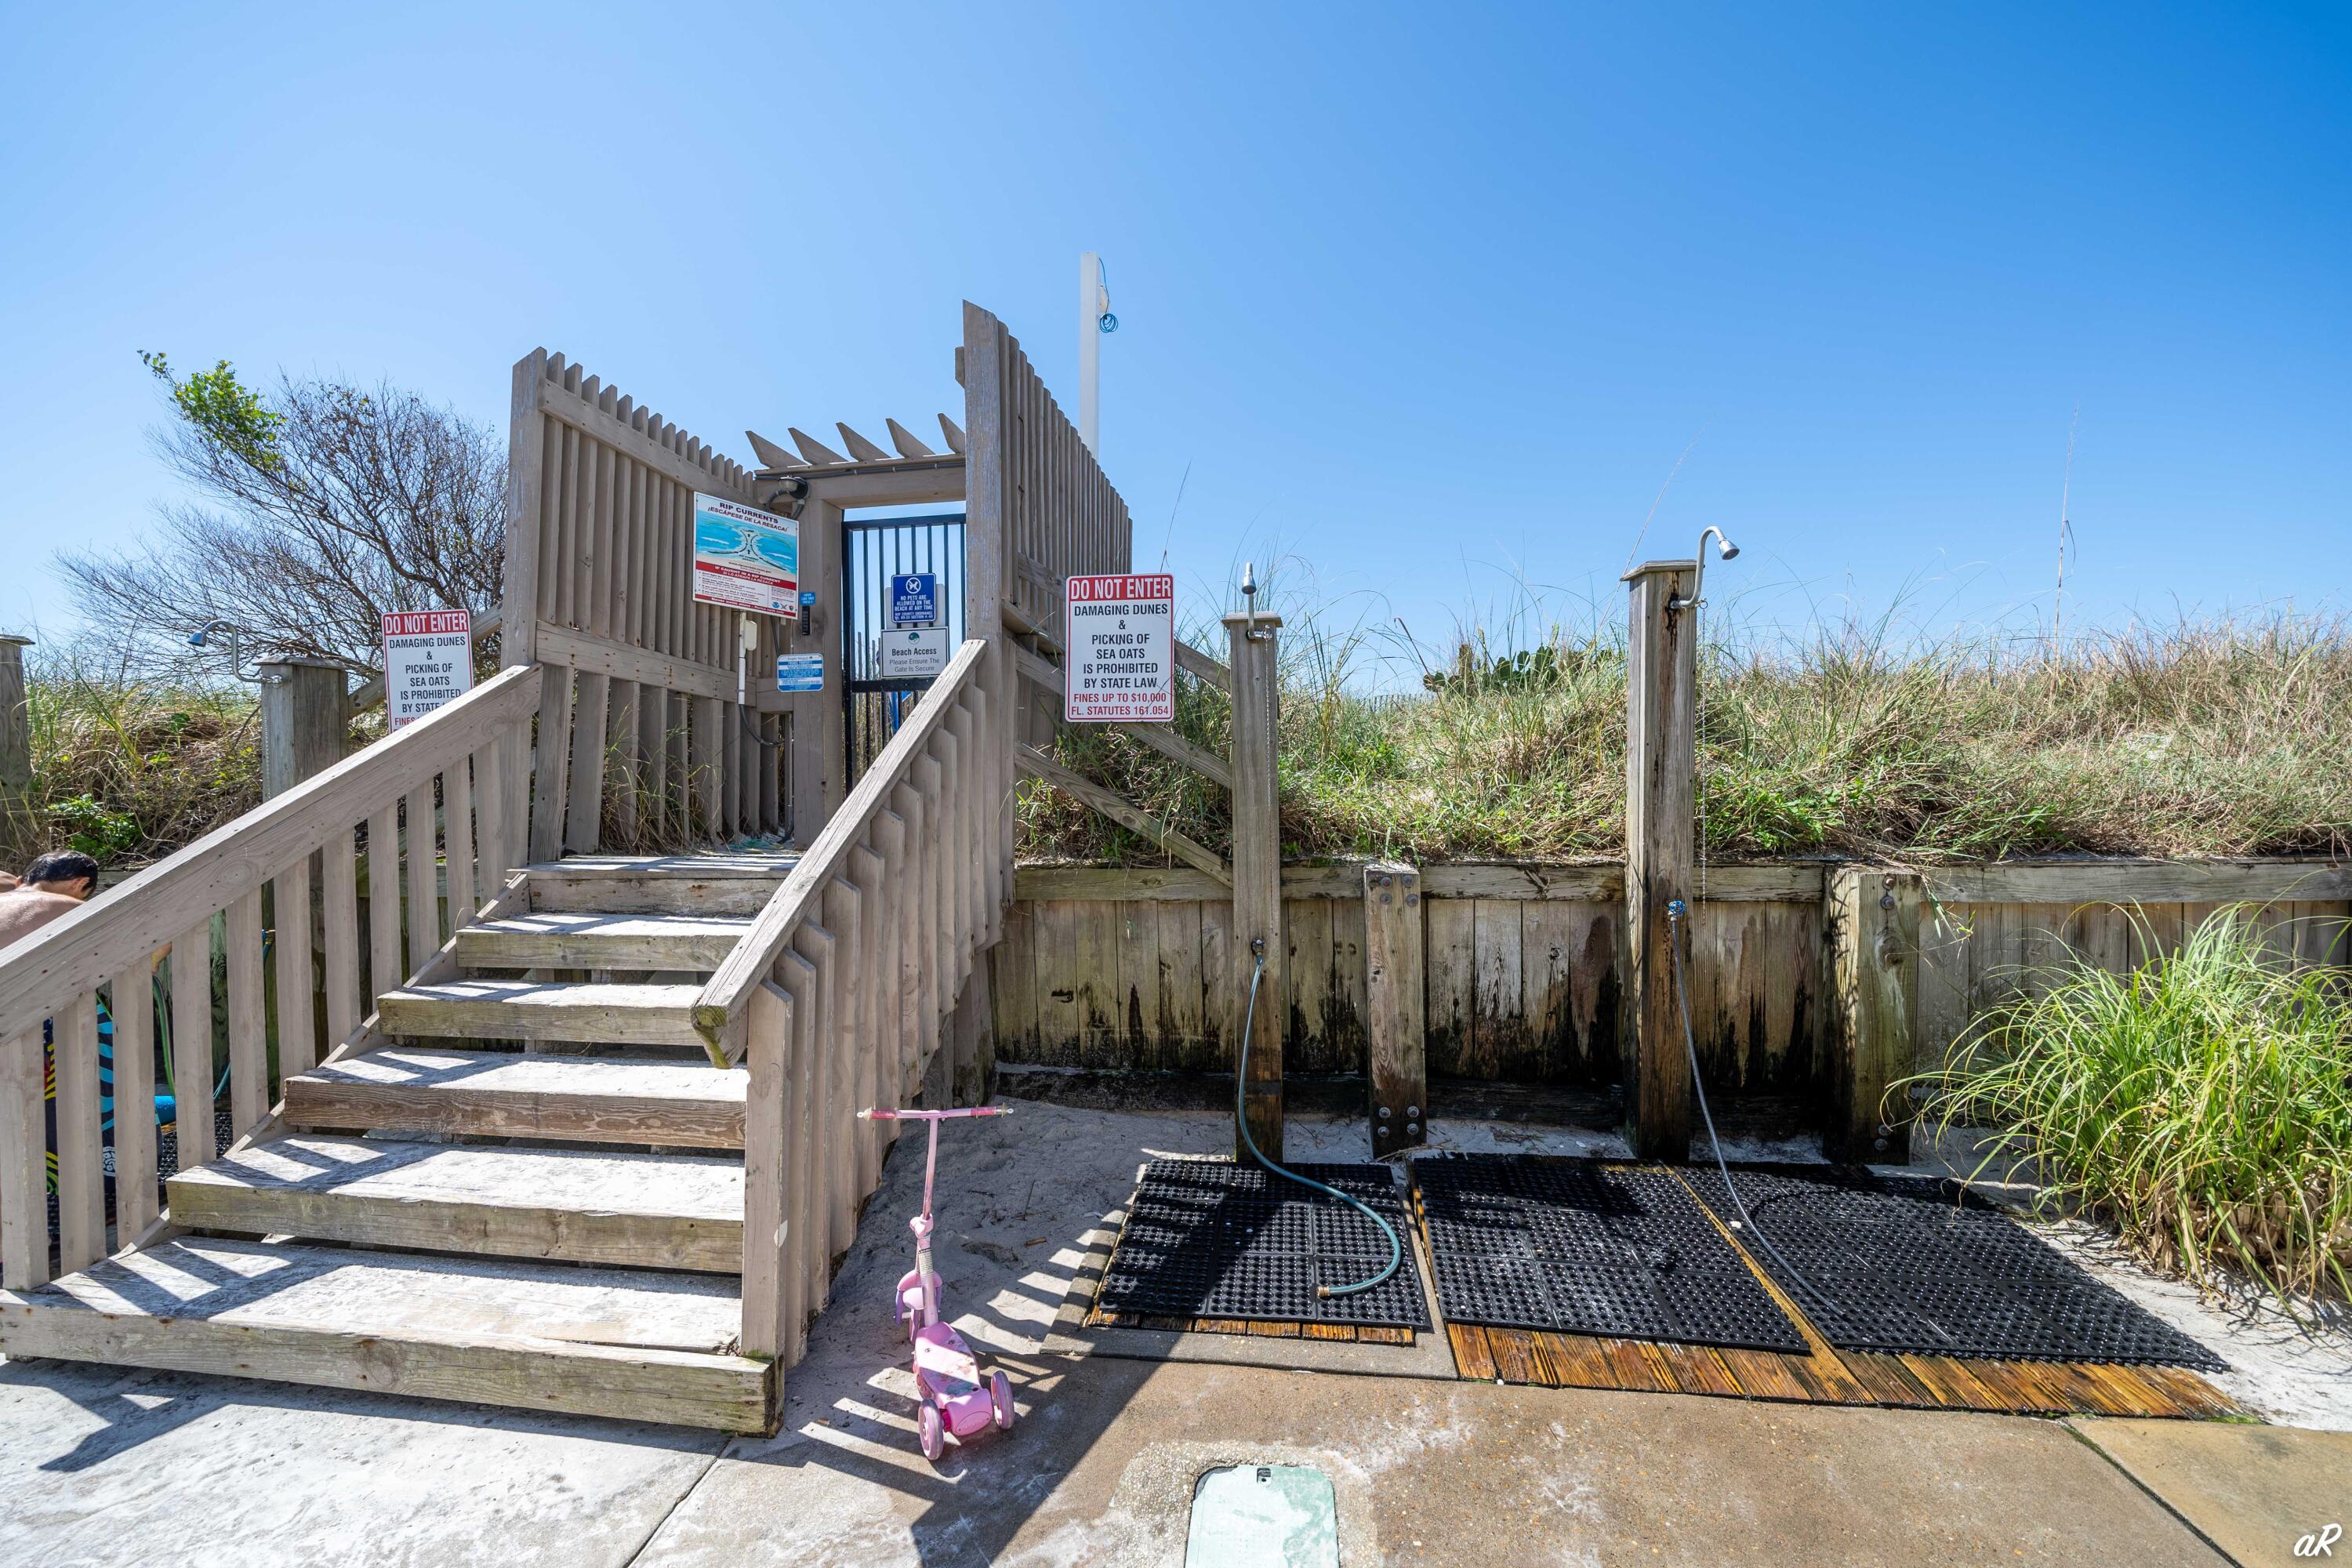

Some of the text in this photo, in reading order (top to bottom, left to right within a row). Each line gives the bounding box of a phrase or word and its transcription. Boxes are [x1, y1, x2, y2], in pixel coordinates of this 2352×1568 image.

[736, 508, 779, 524] CURRENTS
[762, 521, 788, 532] RESACA!
[1071, 577, 1171, 600] DO NOT ENTER
[1074, 604, 1168, 616] DAMAGING DUNES
[385, 613, 467, 634] DO NOT ENTER
[1118, 620, 1126, 629] &
[389, 637, 465, 648] DAMAGING DUNES
[1092, 633, 1150, 645] PICKING OF
[426, 651, 433, 660] &
[892, 648, 911, 656] Beach
[1096, 648, 1145, 659] SEA OATS
[405, 663, 453, 674] PICKING OF
[1083, 663, 1158, 674] IS PROHIBITED
[410, 677, 450, 687] SEA OATS
[1084, 678, 1157, 688] BY STATE LAW
[401, 689, 461, 700] IS PROHIBITED
[1074, 693, 1166, 703] FINES UP TO $10,000
[402, 704, 412, 713] BY
[1071, 706, 1168, 715] FL. STATUTES 161.054
